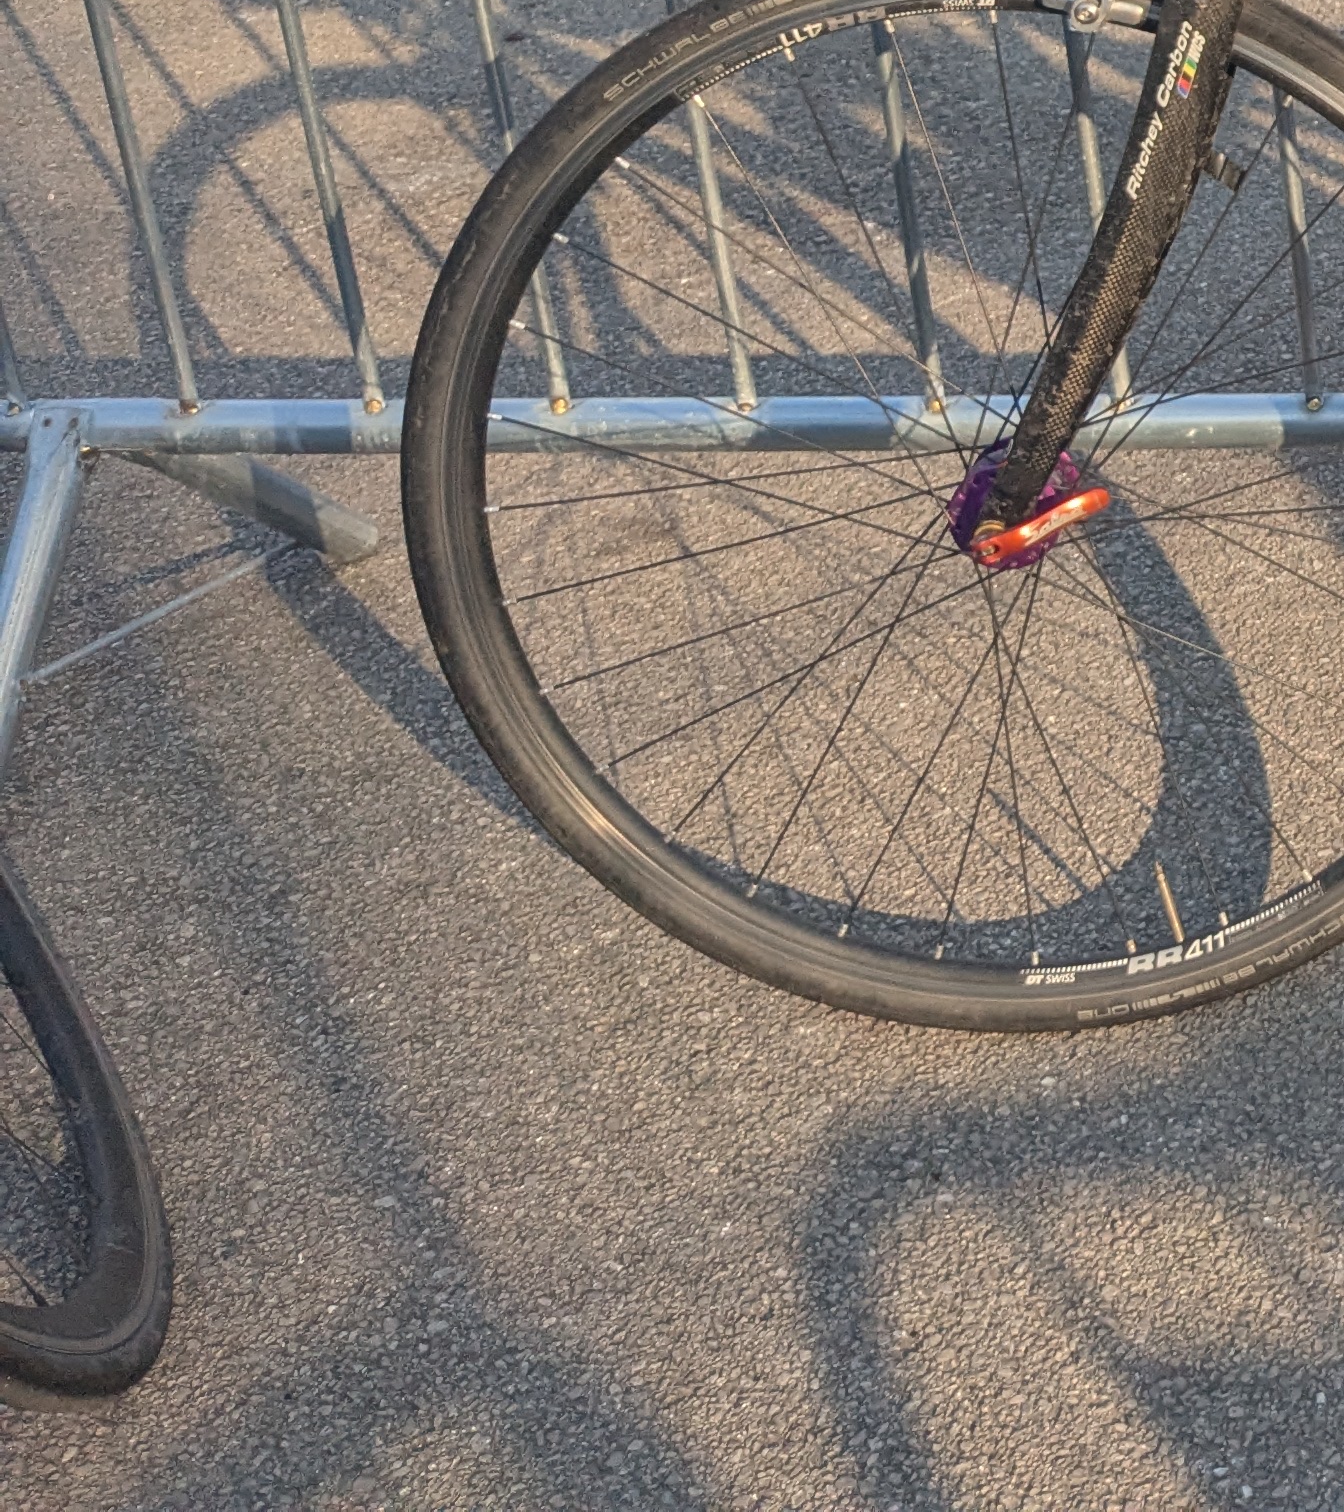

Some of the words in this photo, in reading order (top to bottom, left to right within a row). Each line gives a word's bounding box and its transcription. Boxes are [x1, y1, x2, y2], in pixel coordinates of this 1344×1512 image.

[603, 4, 749, 102] SCHWALBE
[1187, 33, 1207, 67] WCS
[1124, 110, 1166, 201] Ritchey
[1156, 20, 1194, 109] Carbon
[1127, 929, 1228, 975] RR411
[1024, 974, 1045, 985] DT
[1045, 970, 1077, 984] SWISS
